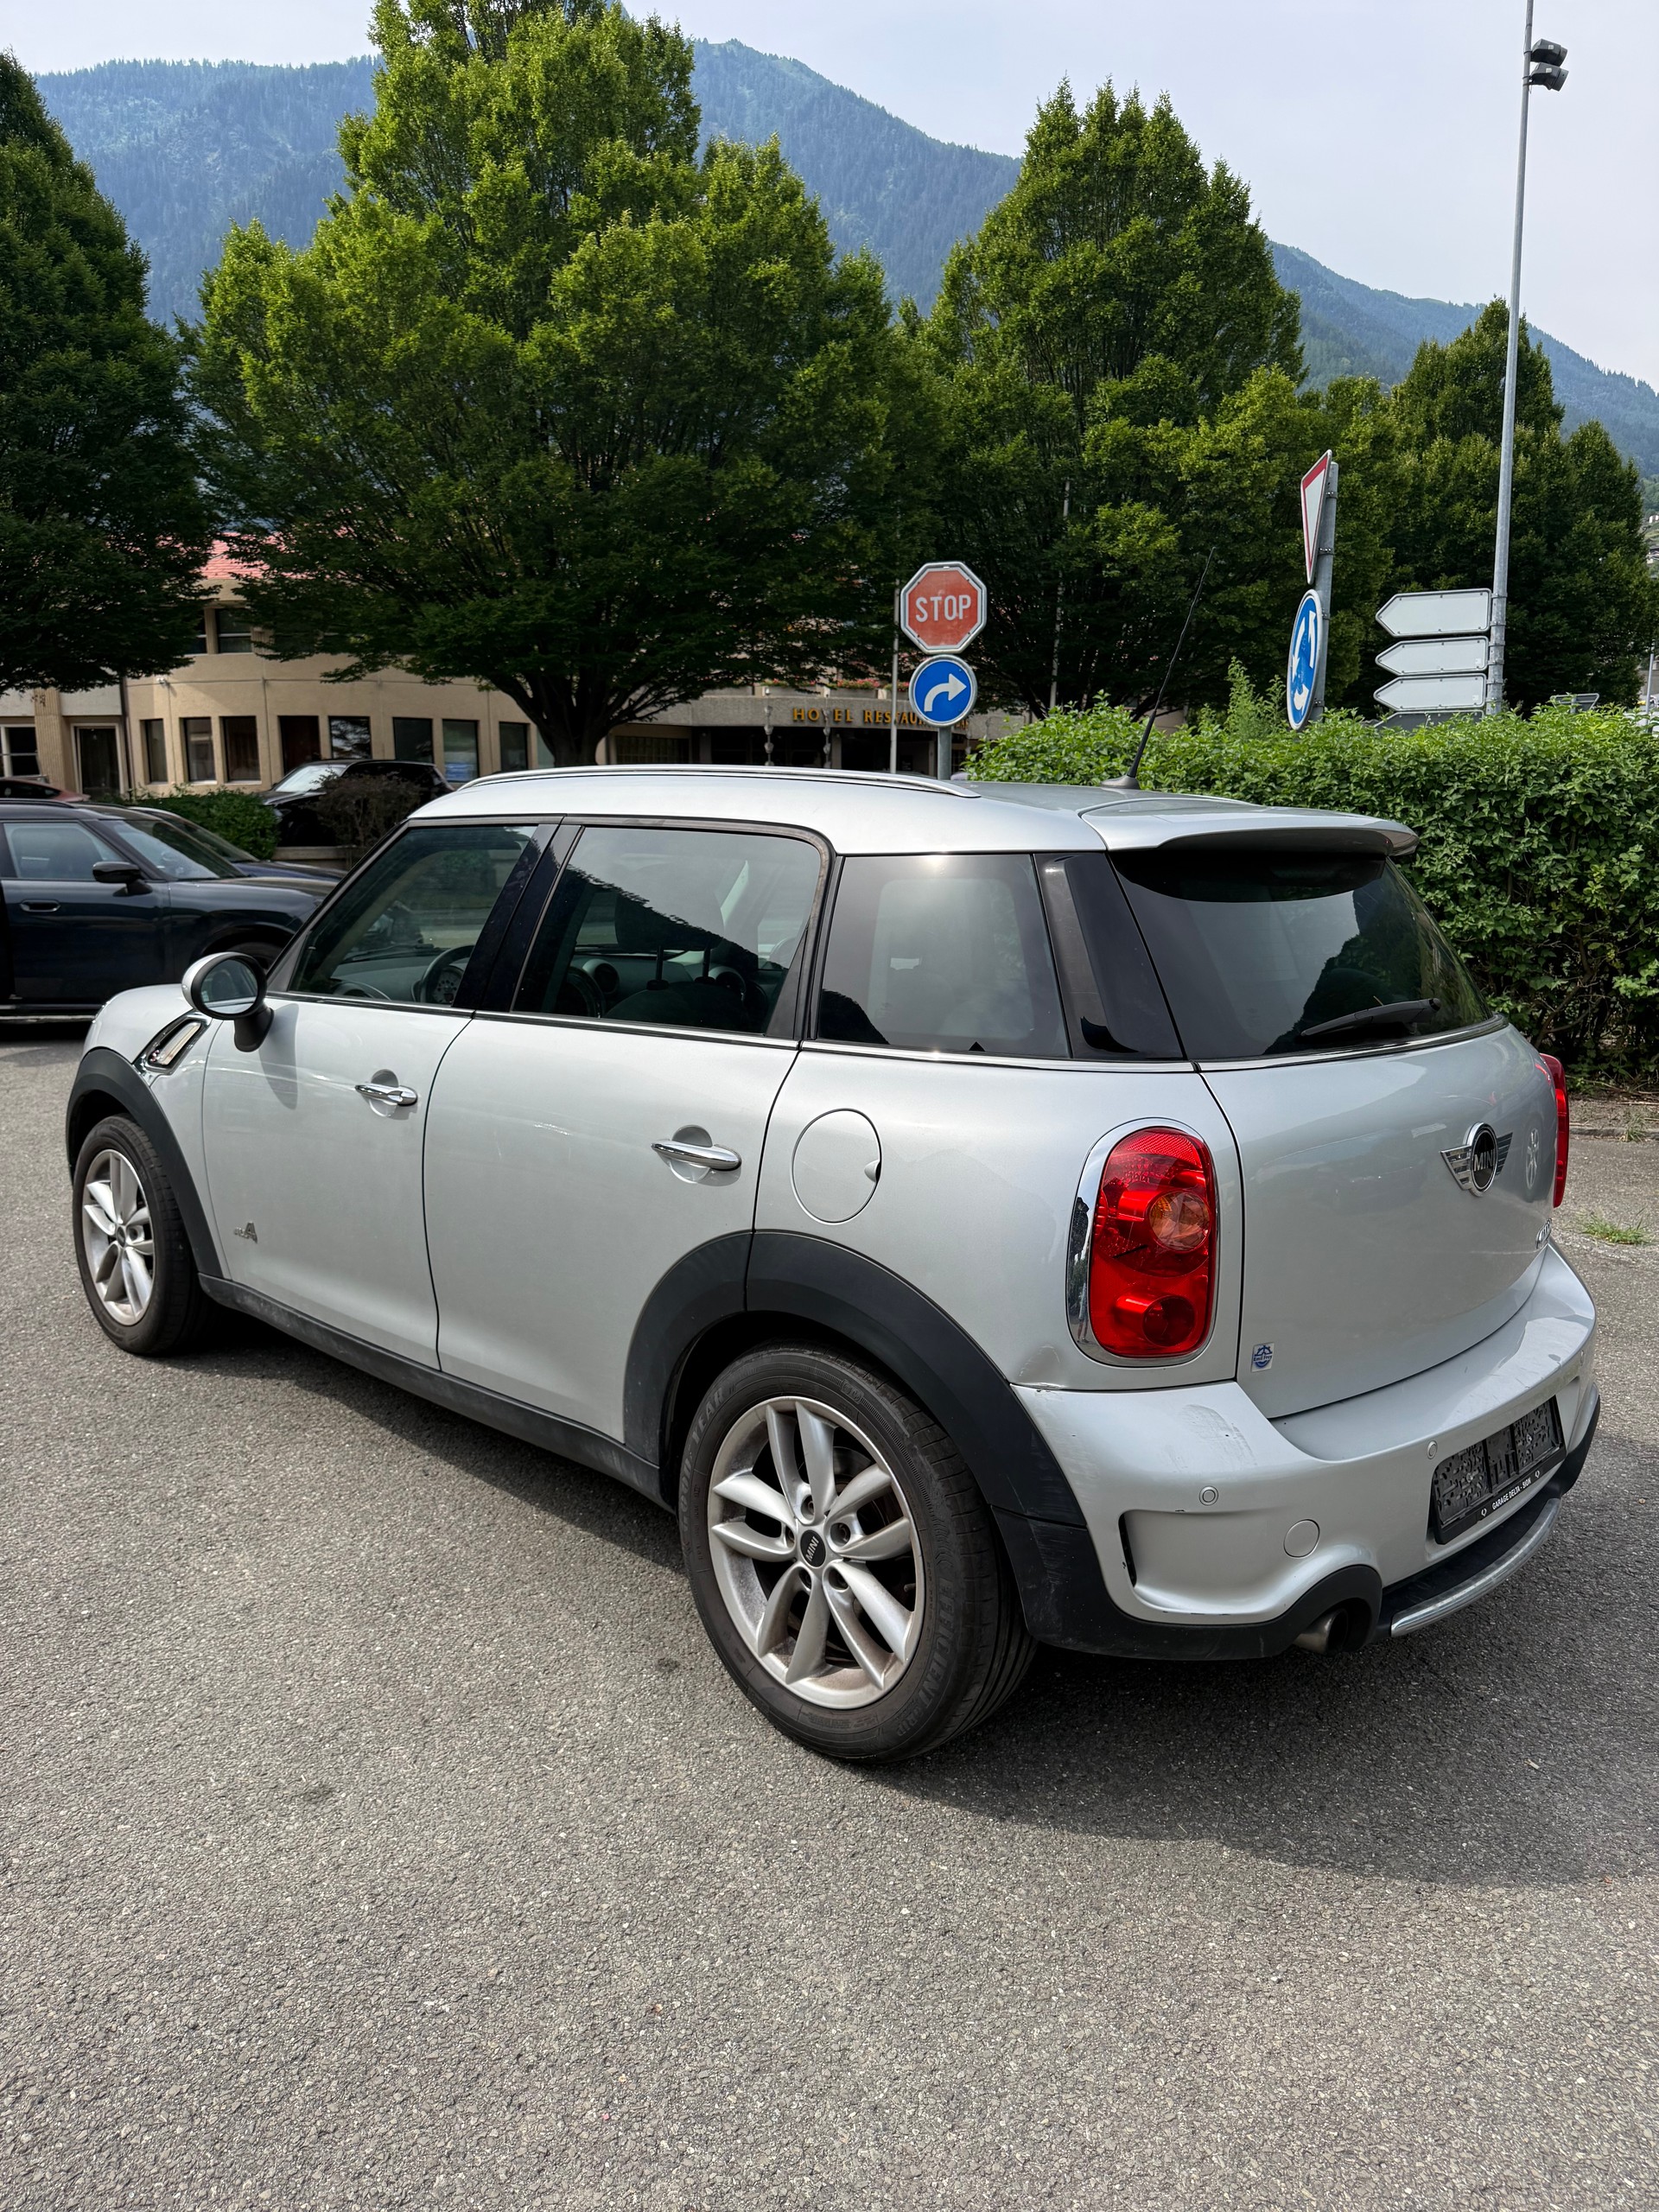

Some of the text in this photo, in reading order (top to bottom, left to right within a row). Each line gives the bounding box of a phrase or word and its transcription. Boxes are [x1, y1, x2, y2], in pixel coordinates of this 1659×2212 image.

[916, 594, 971, 622] STOP
[792, 707, 854, 722] HOEL
[1474, 1149, 1495, 1172] MINI
[1491, 1493, 1509, 1510] GARAGE
[1509, 1485, 1521, 1498] DELTA
[1522, 1478, 1531, 1489] SION
[805, 1535, 819, 1562] MINI
